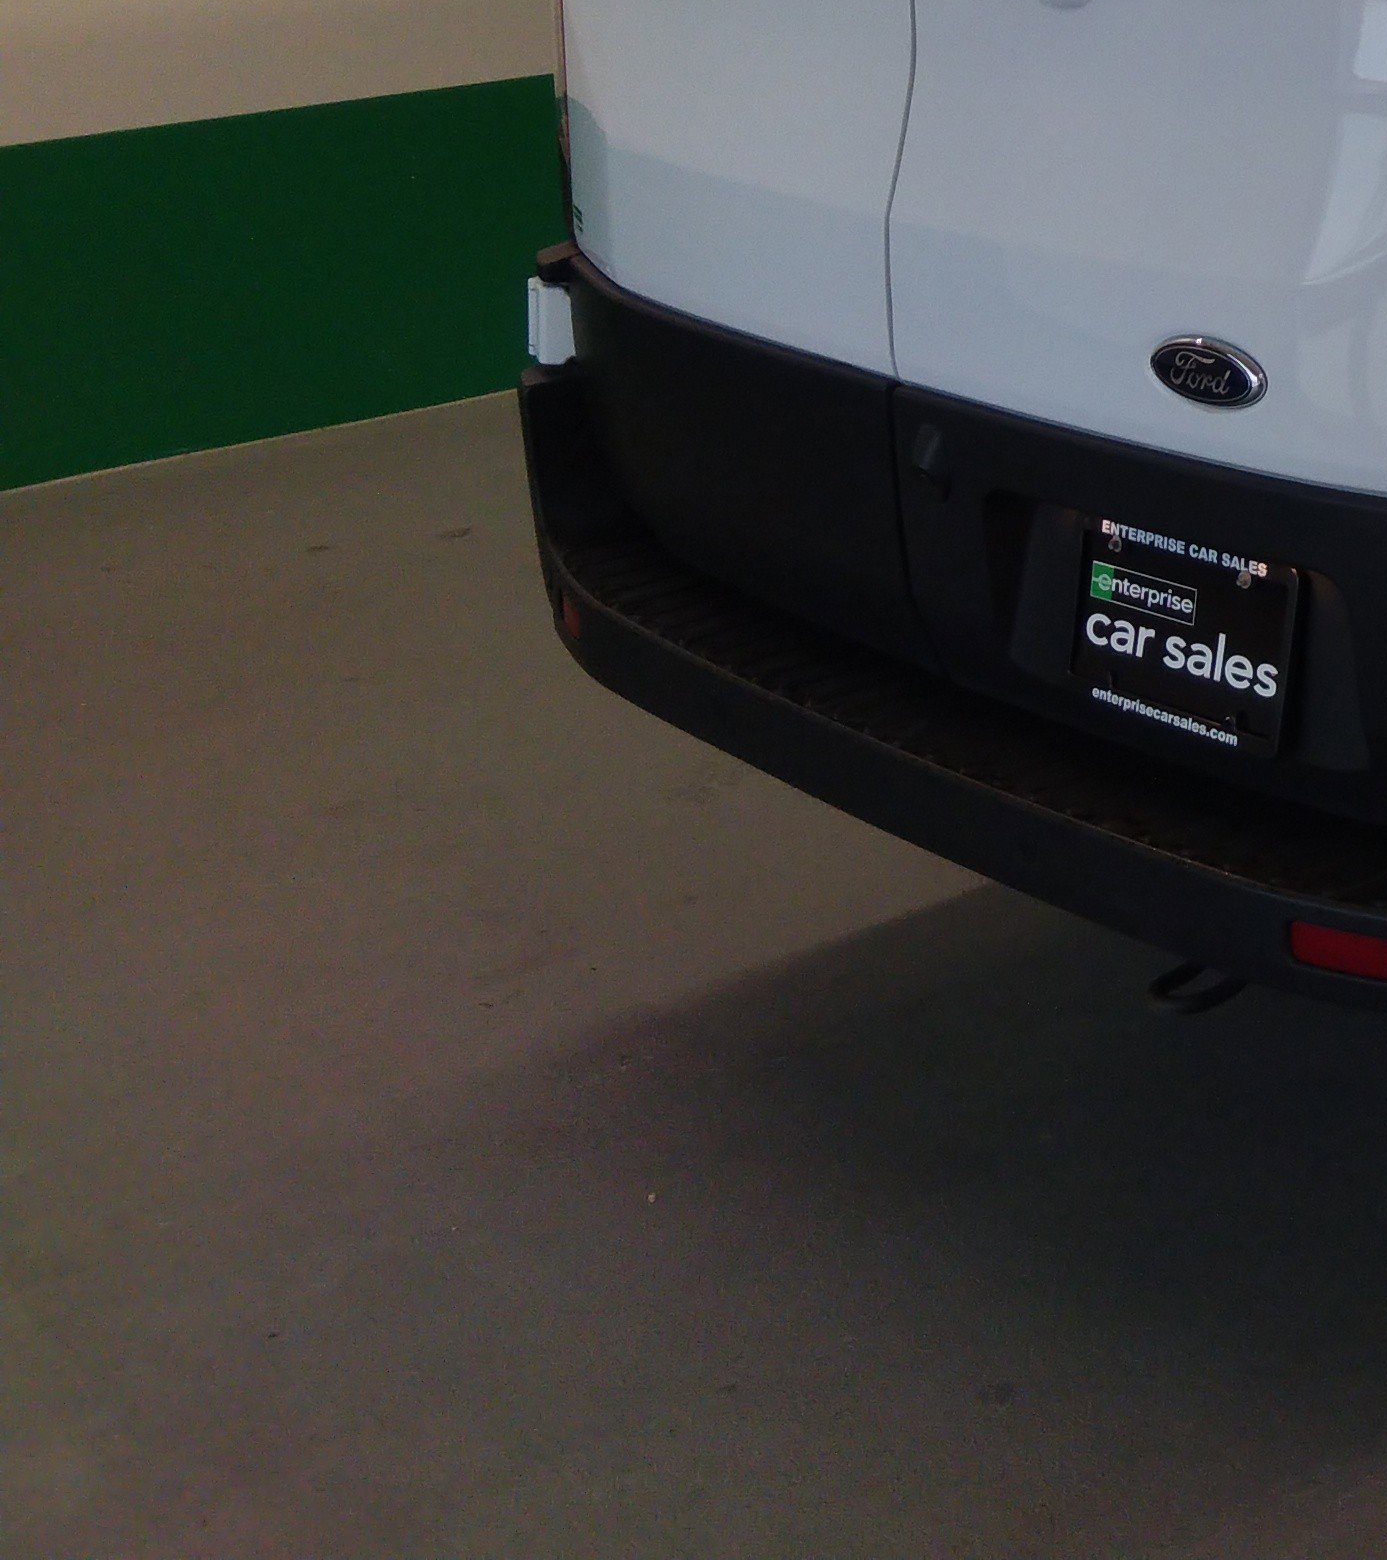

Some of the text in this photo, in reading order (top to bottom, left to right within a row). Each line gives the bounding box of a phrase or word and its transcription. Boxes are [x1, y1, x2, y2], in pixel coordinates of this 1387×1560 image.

[1169, 350, 1232, 395] Ford
[1101, 519, 1268, 578] ENTERPRISE CAR SALES
[1095, 572, 1194, 614] enterprise
[1085, 612, 1279, 698] car sales
[1091, 686, 1238, 747] enterprisecarsales.com
